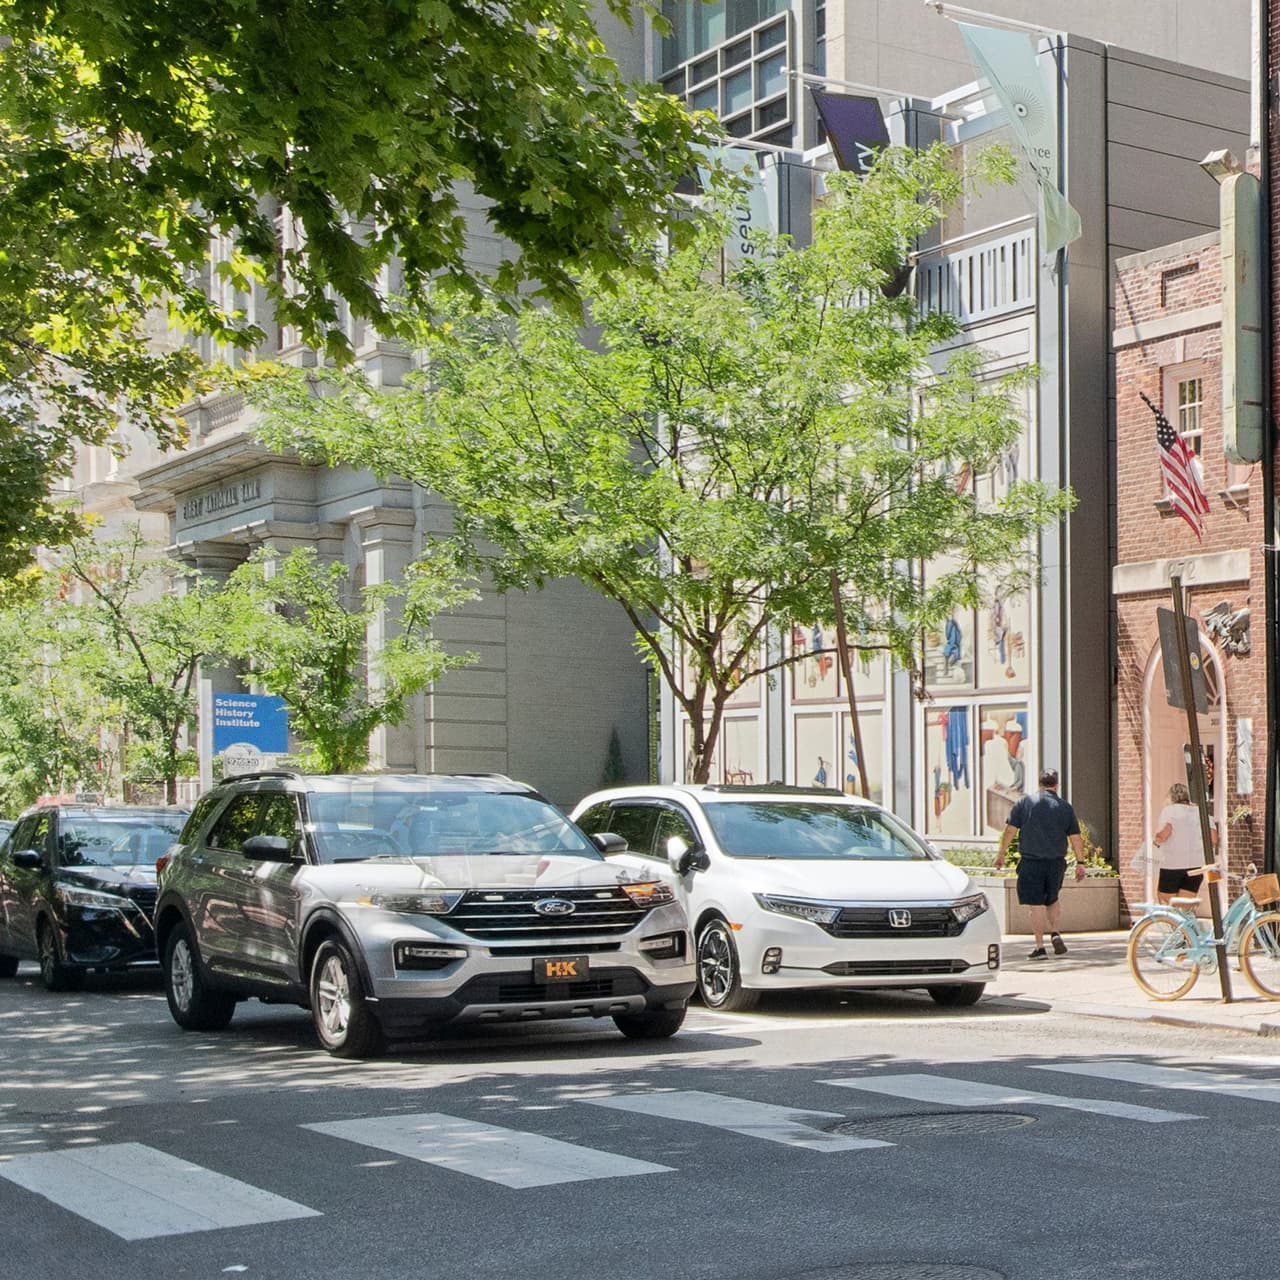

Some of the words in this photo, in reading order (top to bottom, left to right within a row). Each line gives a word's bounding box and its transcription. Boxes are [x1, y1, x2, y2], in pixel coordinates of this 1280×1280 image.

[215, 698, 257, 708] Science
[215, 708, 254, 718] History
[215, 718, 260, 727] Institute
[545, 902, 567, 912] Ford
